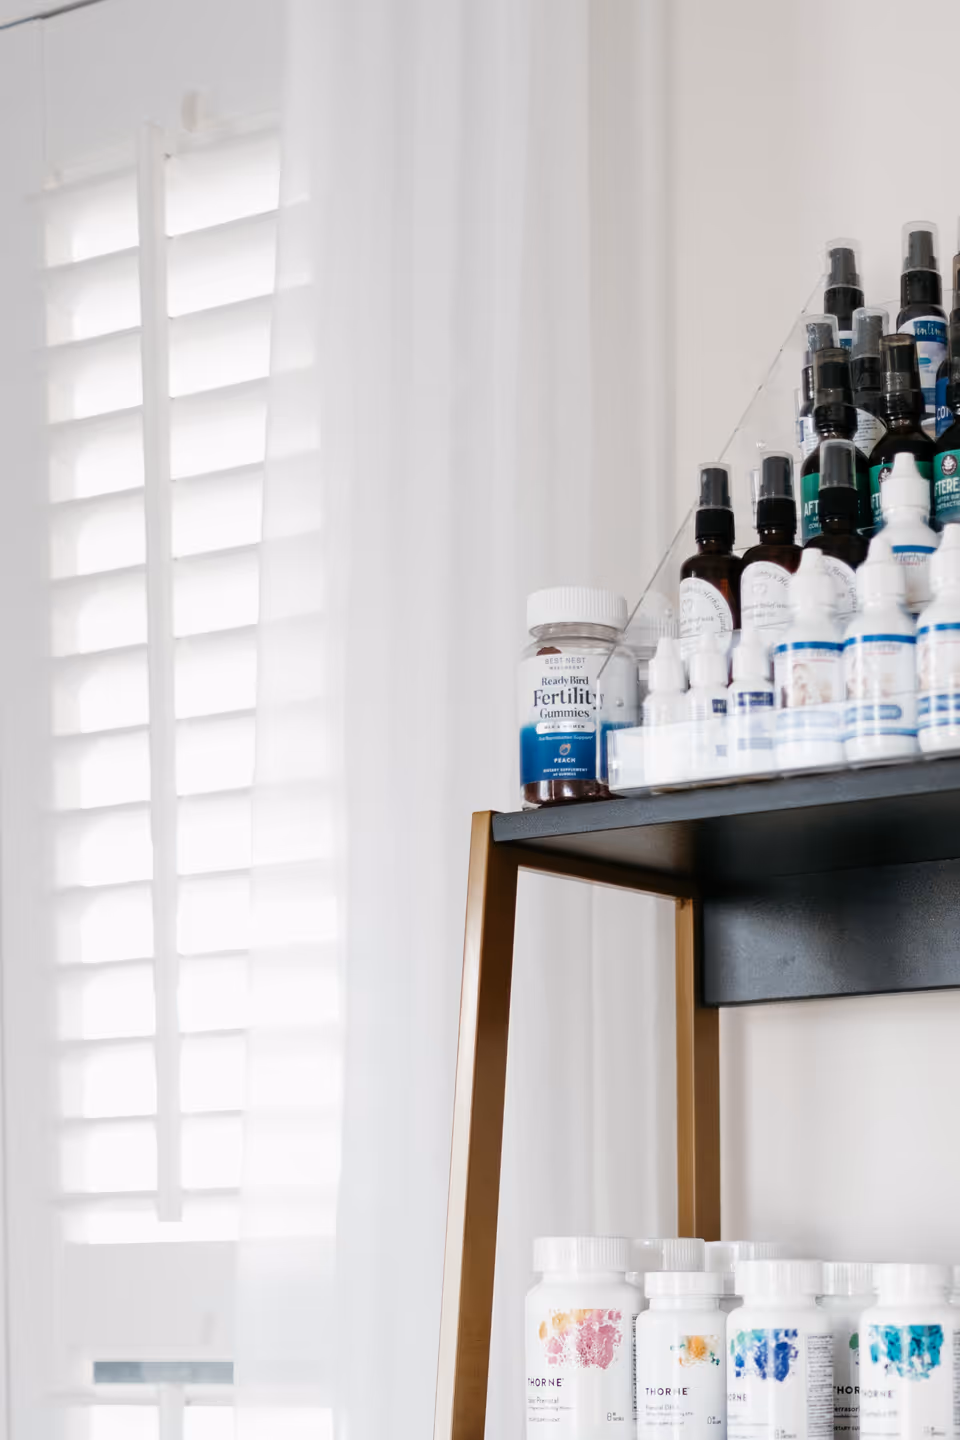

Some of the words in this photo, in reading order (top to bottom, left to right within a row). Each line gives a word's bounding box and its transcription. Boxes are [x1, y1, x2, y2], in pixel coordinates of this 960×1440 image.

[541, 676, 569, 687] Ready
[570, 675, 589, 685] Bird
[533, 686, 604, 710] Fertility
[539, 706, 590, 719] Gummies
